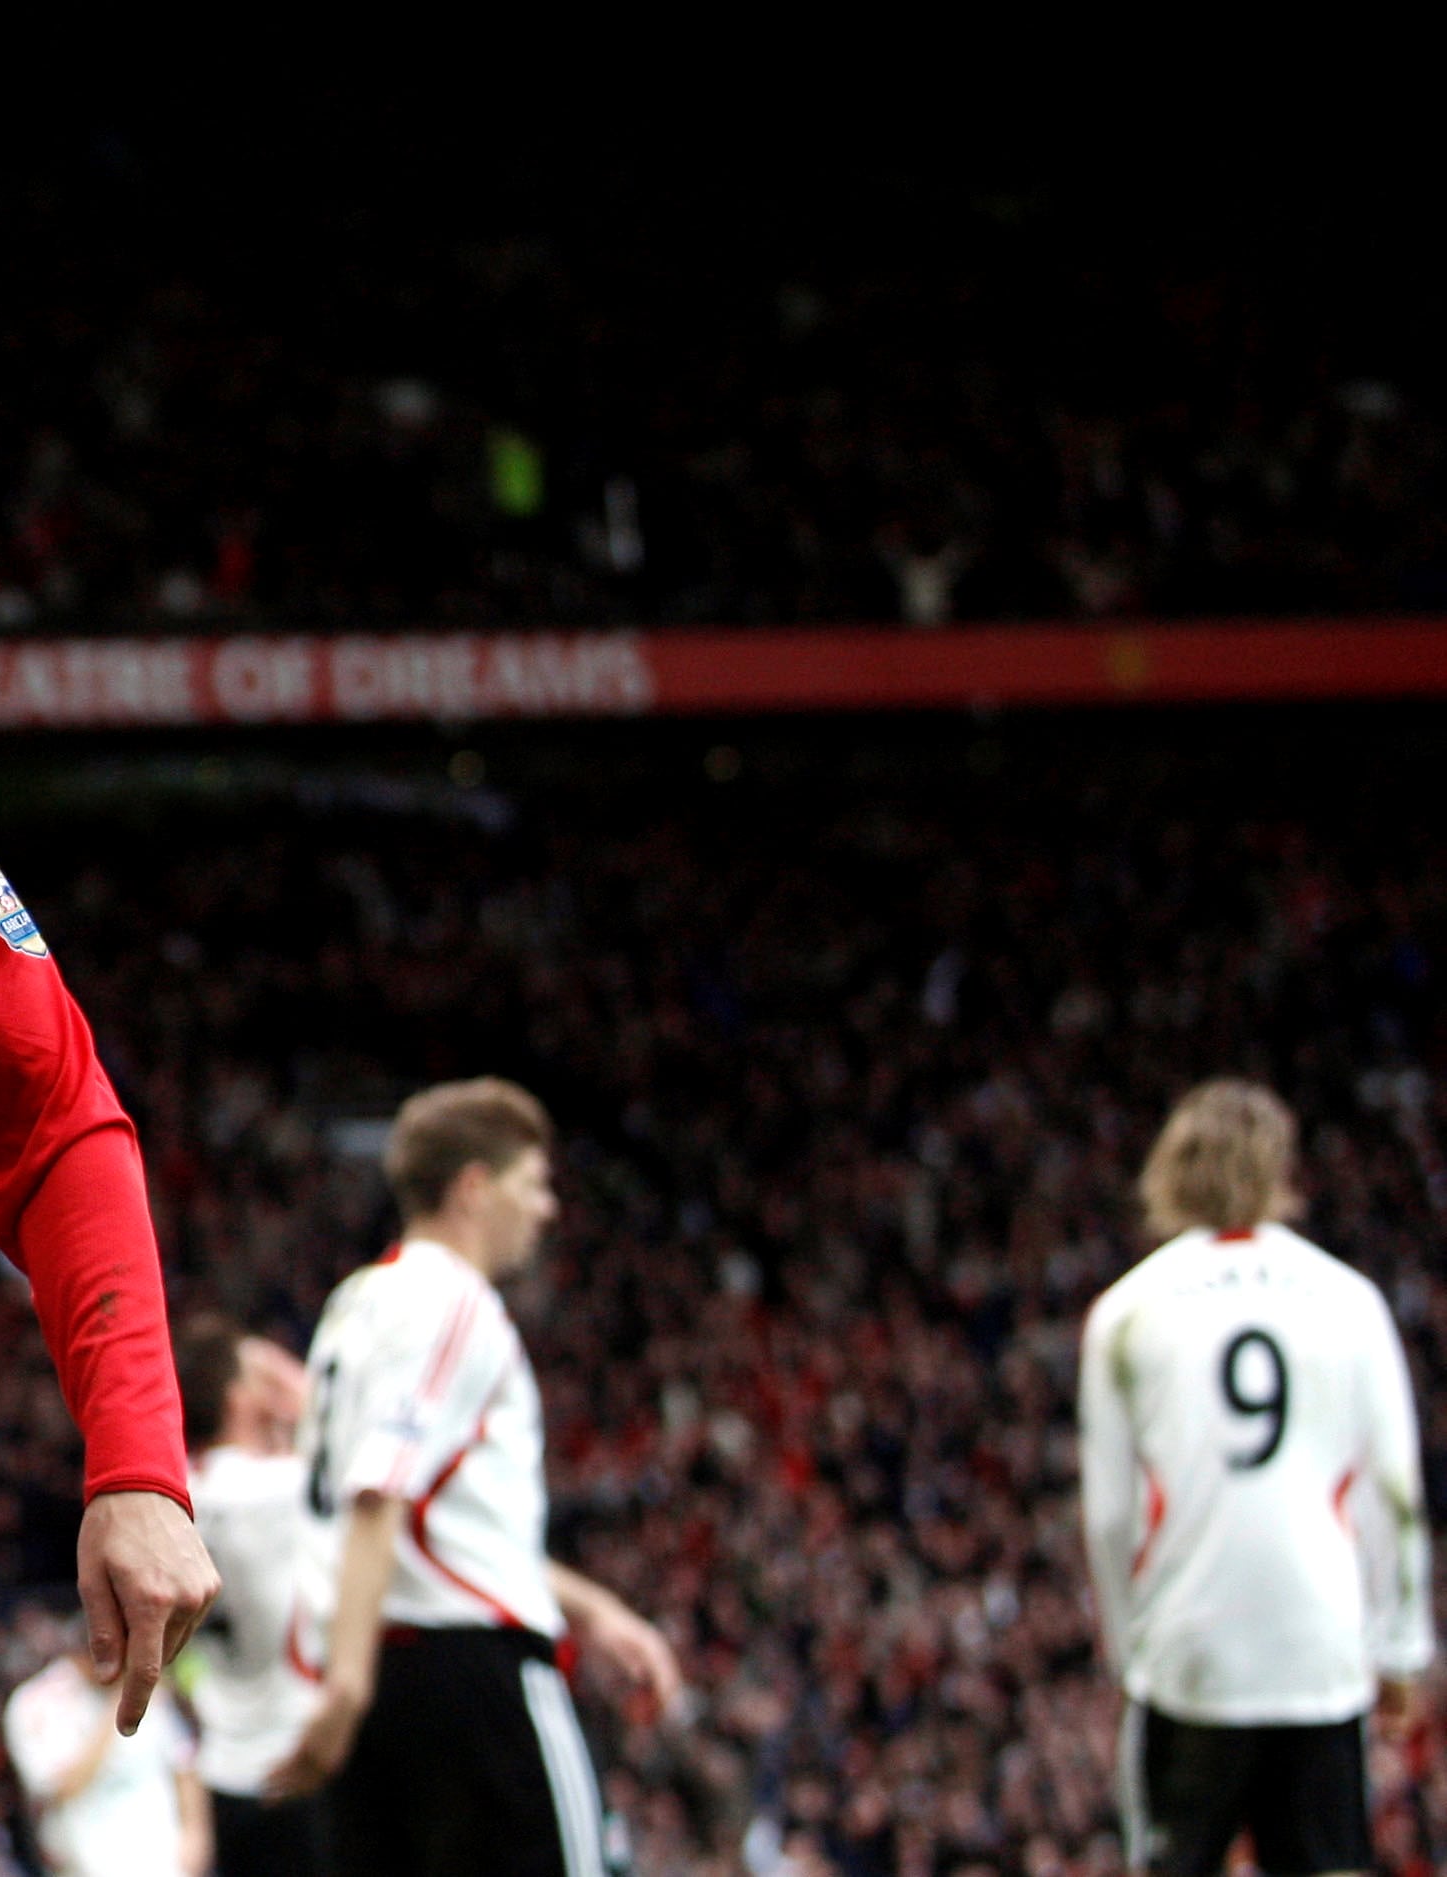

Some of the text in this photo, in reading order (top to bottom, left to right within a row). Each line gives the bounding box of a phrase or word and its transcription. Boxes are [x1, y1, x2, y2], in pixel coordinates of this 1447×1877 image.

[210, 638, 312, 720] OF
[328, 634, 656, 718] DREAMS
[1221, 1326, 1292, 1470] 9
